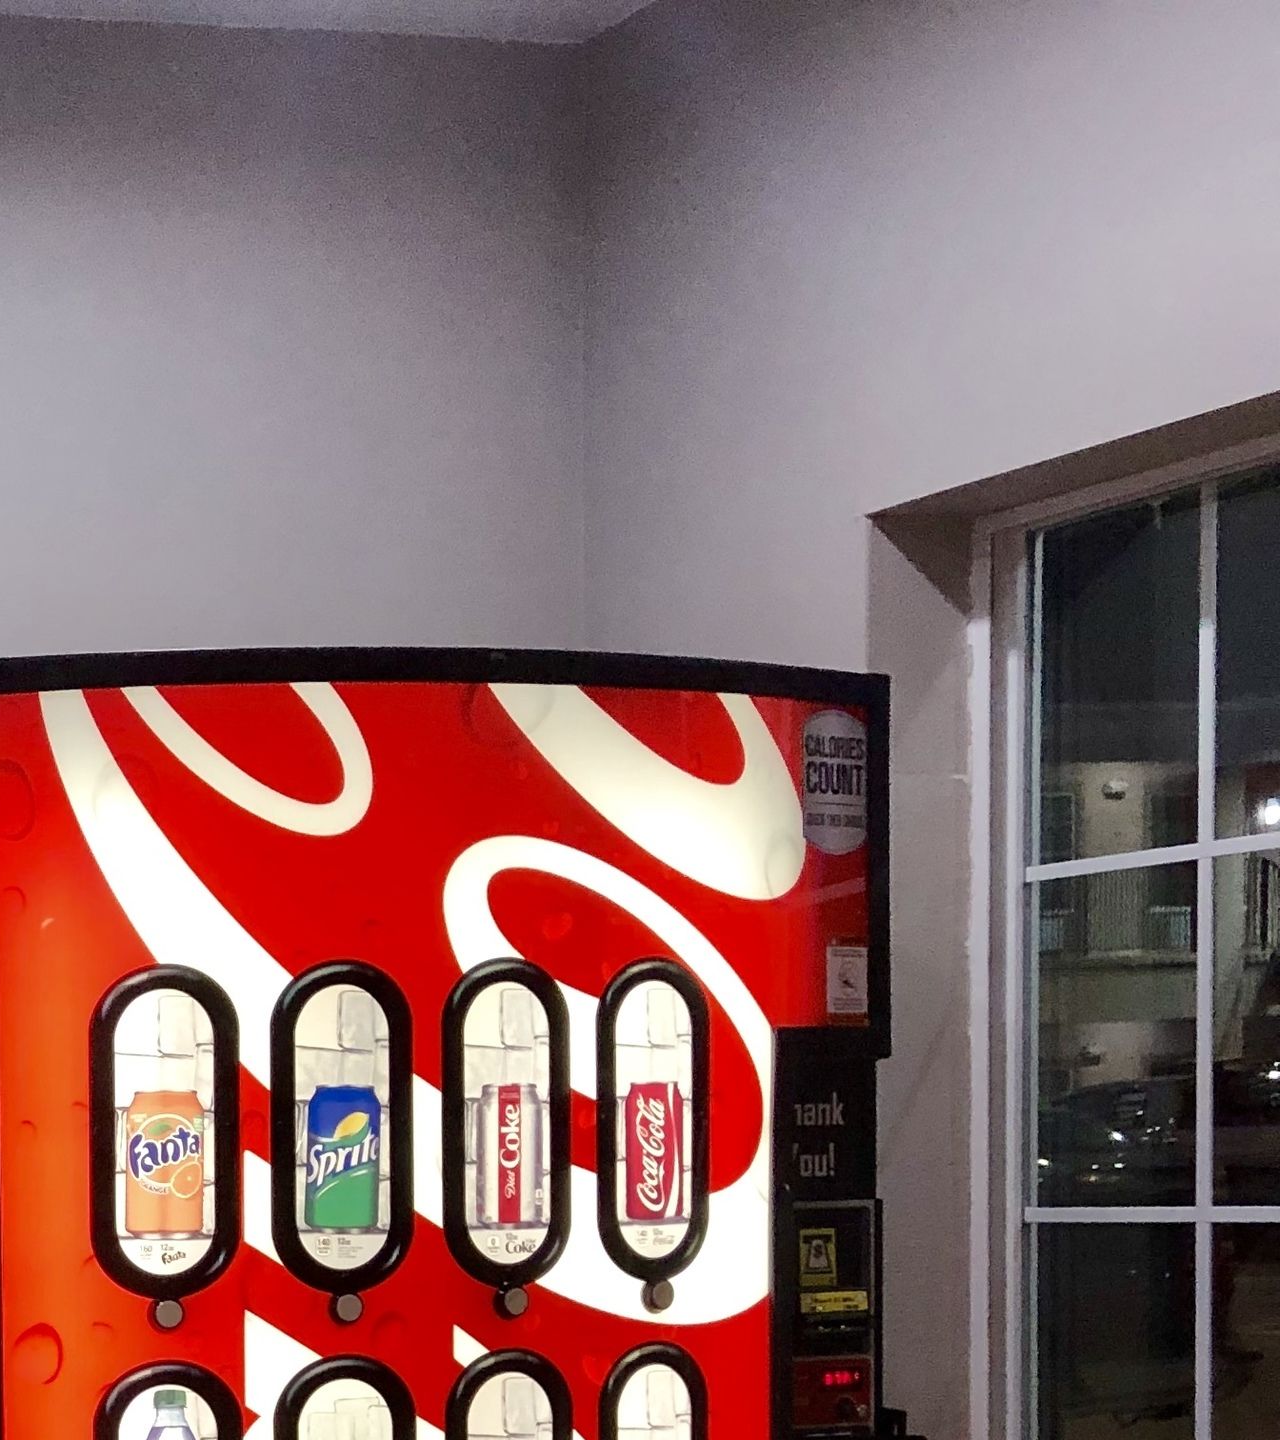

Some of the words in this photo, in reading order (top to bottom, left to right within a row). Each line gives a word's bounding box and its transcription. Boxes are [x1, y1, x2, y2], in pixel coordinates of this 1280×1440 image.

[804, 733, 865, 761] CALORIES
[804, 761, 864, 797] COUNT
[793, 1091, 845, 1127] ank
[128, 1126, 201, 1178] Fanta
[499, 1102, 521, 1169] Coke
[637, 1093, 666, 1212] Coca-Cola
[792, 1142, 837, 1178] ou!
[504, 1168, 517, 1199] Diet
[504, 1240, 536, 1254] Coke
